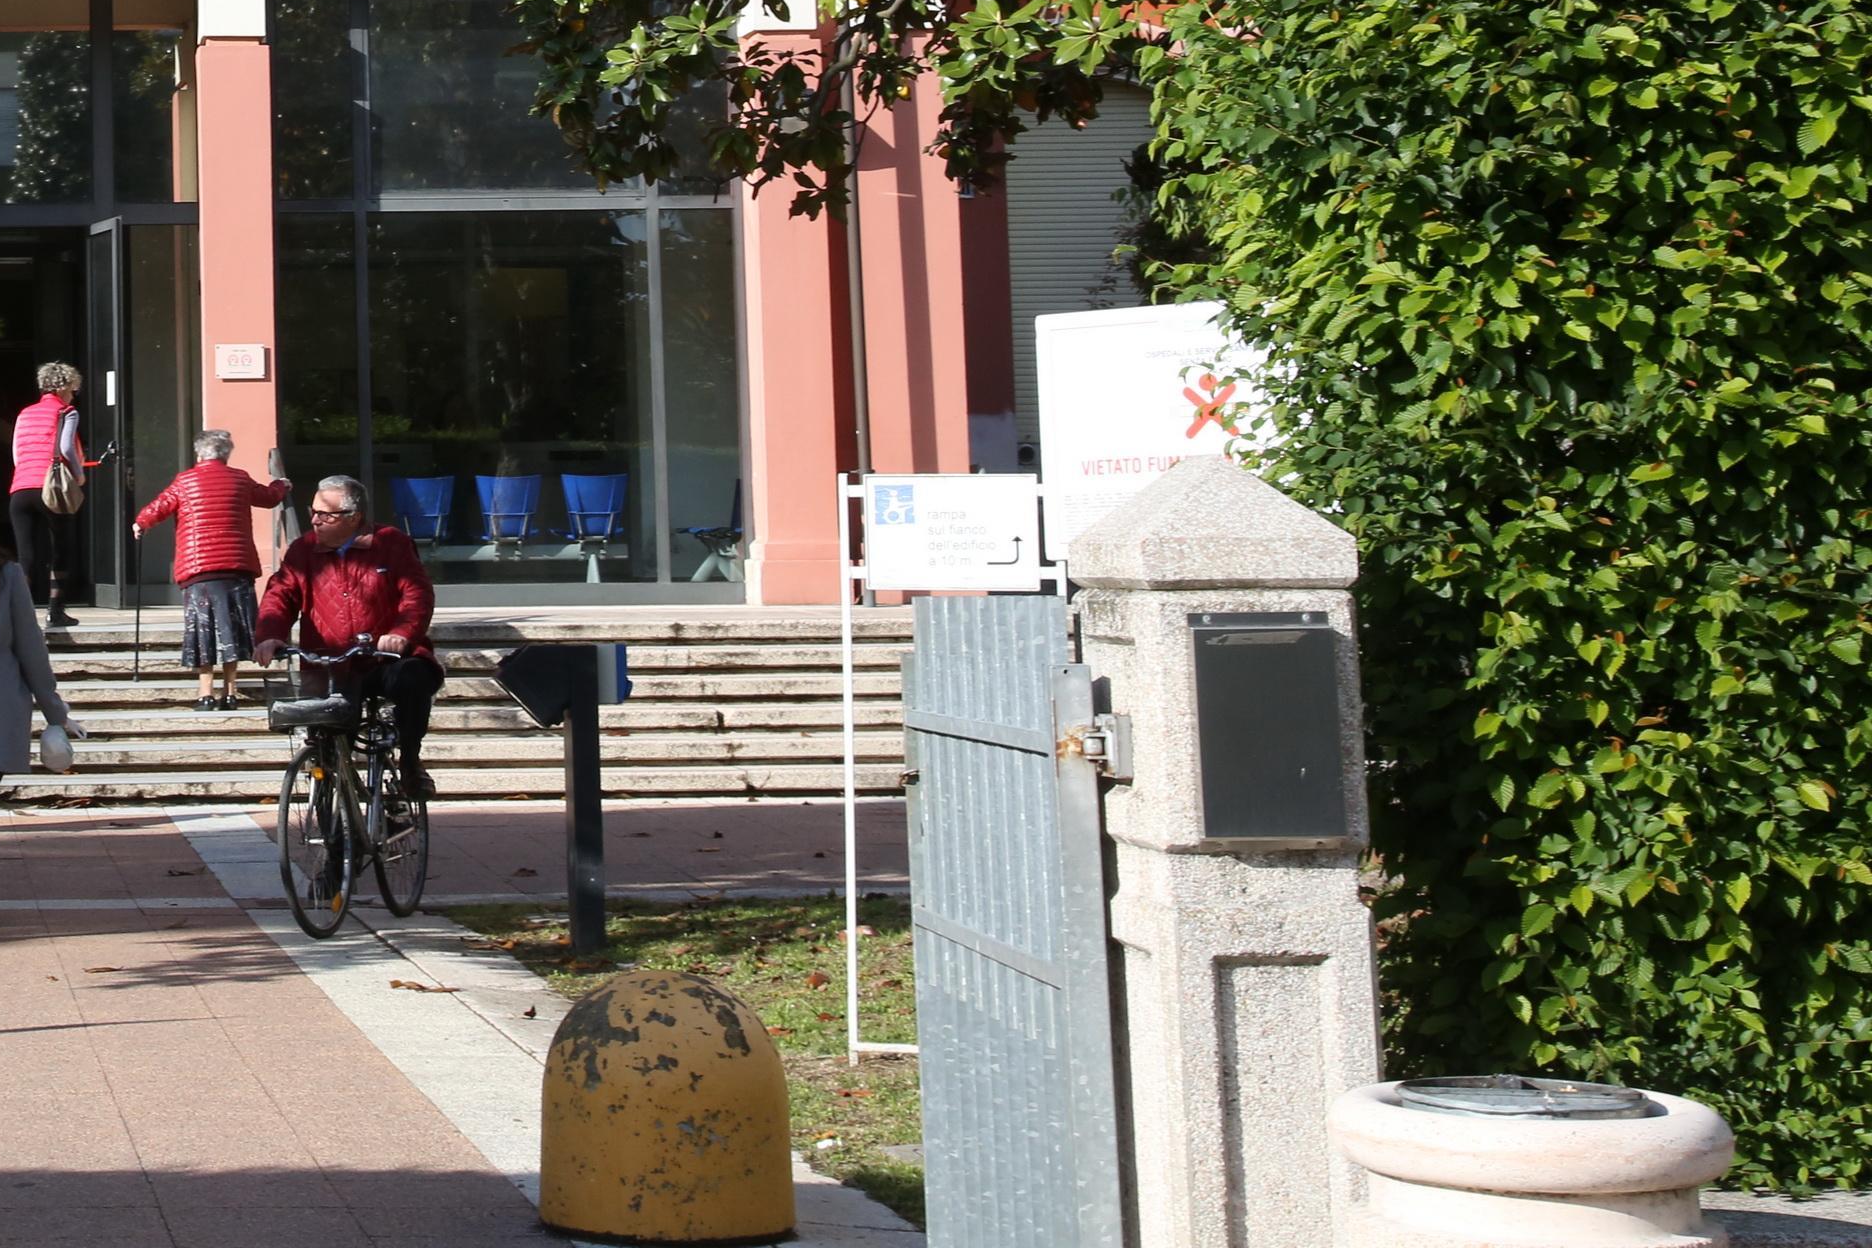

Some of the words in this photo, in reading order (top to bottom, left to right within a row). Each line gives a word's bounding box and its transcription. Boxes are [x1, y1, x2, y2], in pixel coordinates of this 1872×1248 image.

[1082, 457, 1142, 475] VIETATO
[1148, 454, 1192, 472] FUM
[928, 511, 966, 521] rampa
[927, 524, 946, 536] sul
[949, 524, 987, 536] fianco
[928, 557, 936, 566] a
